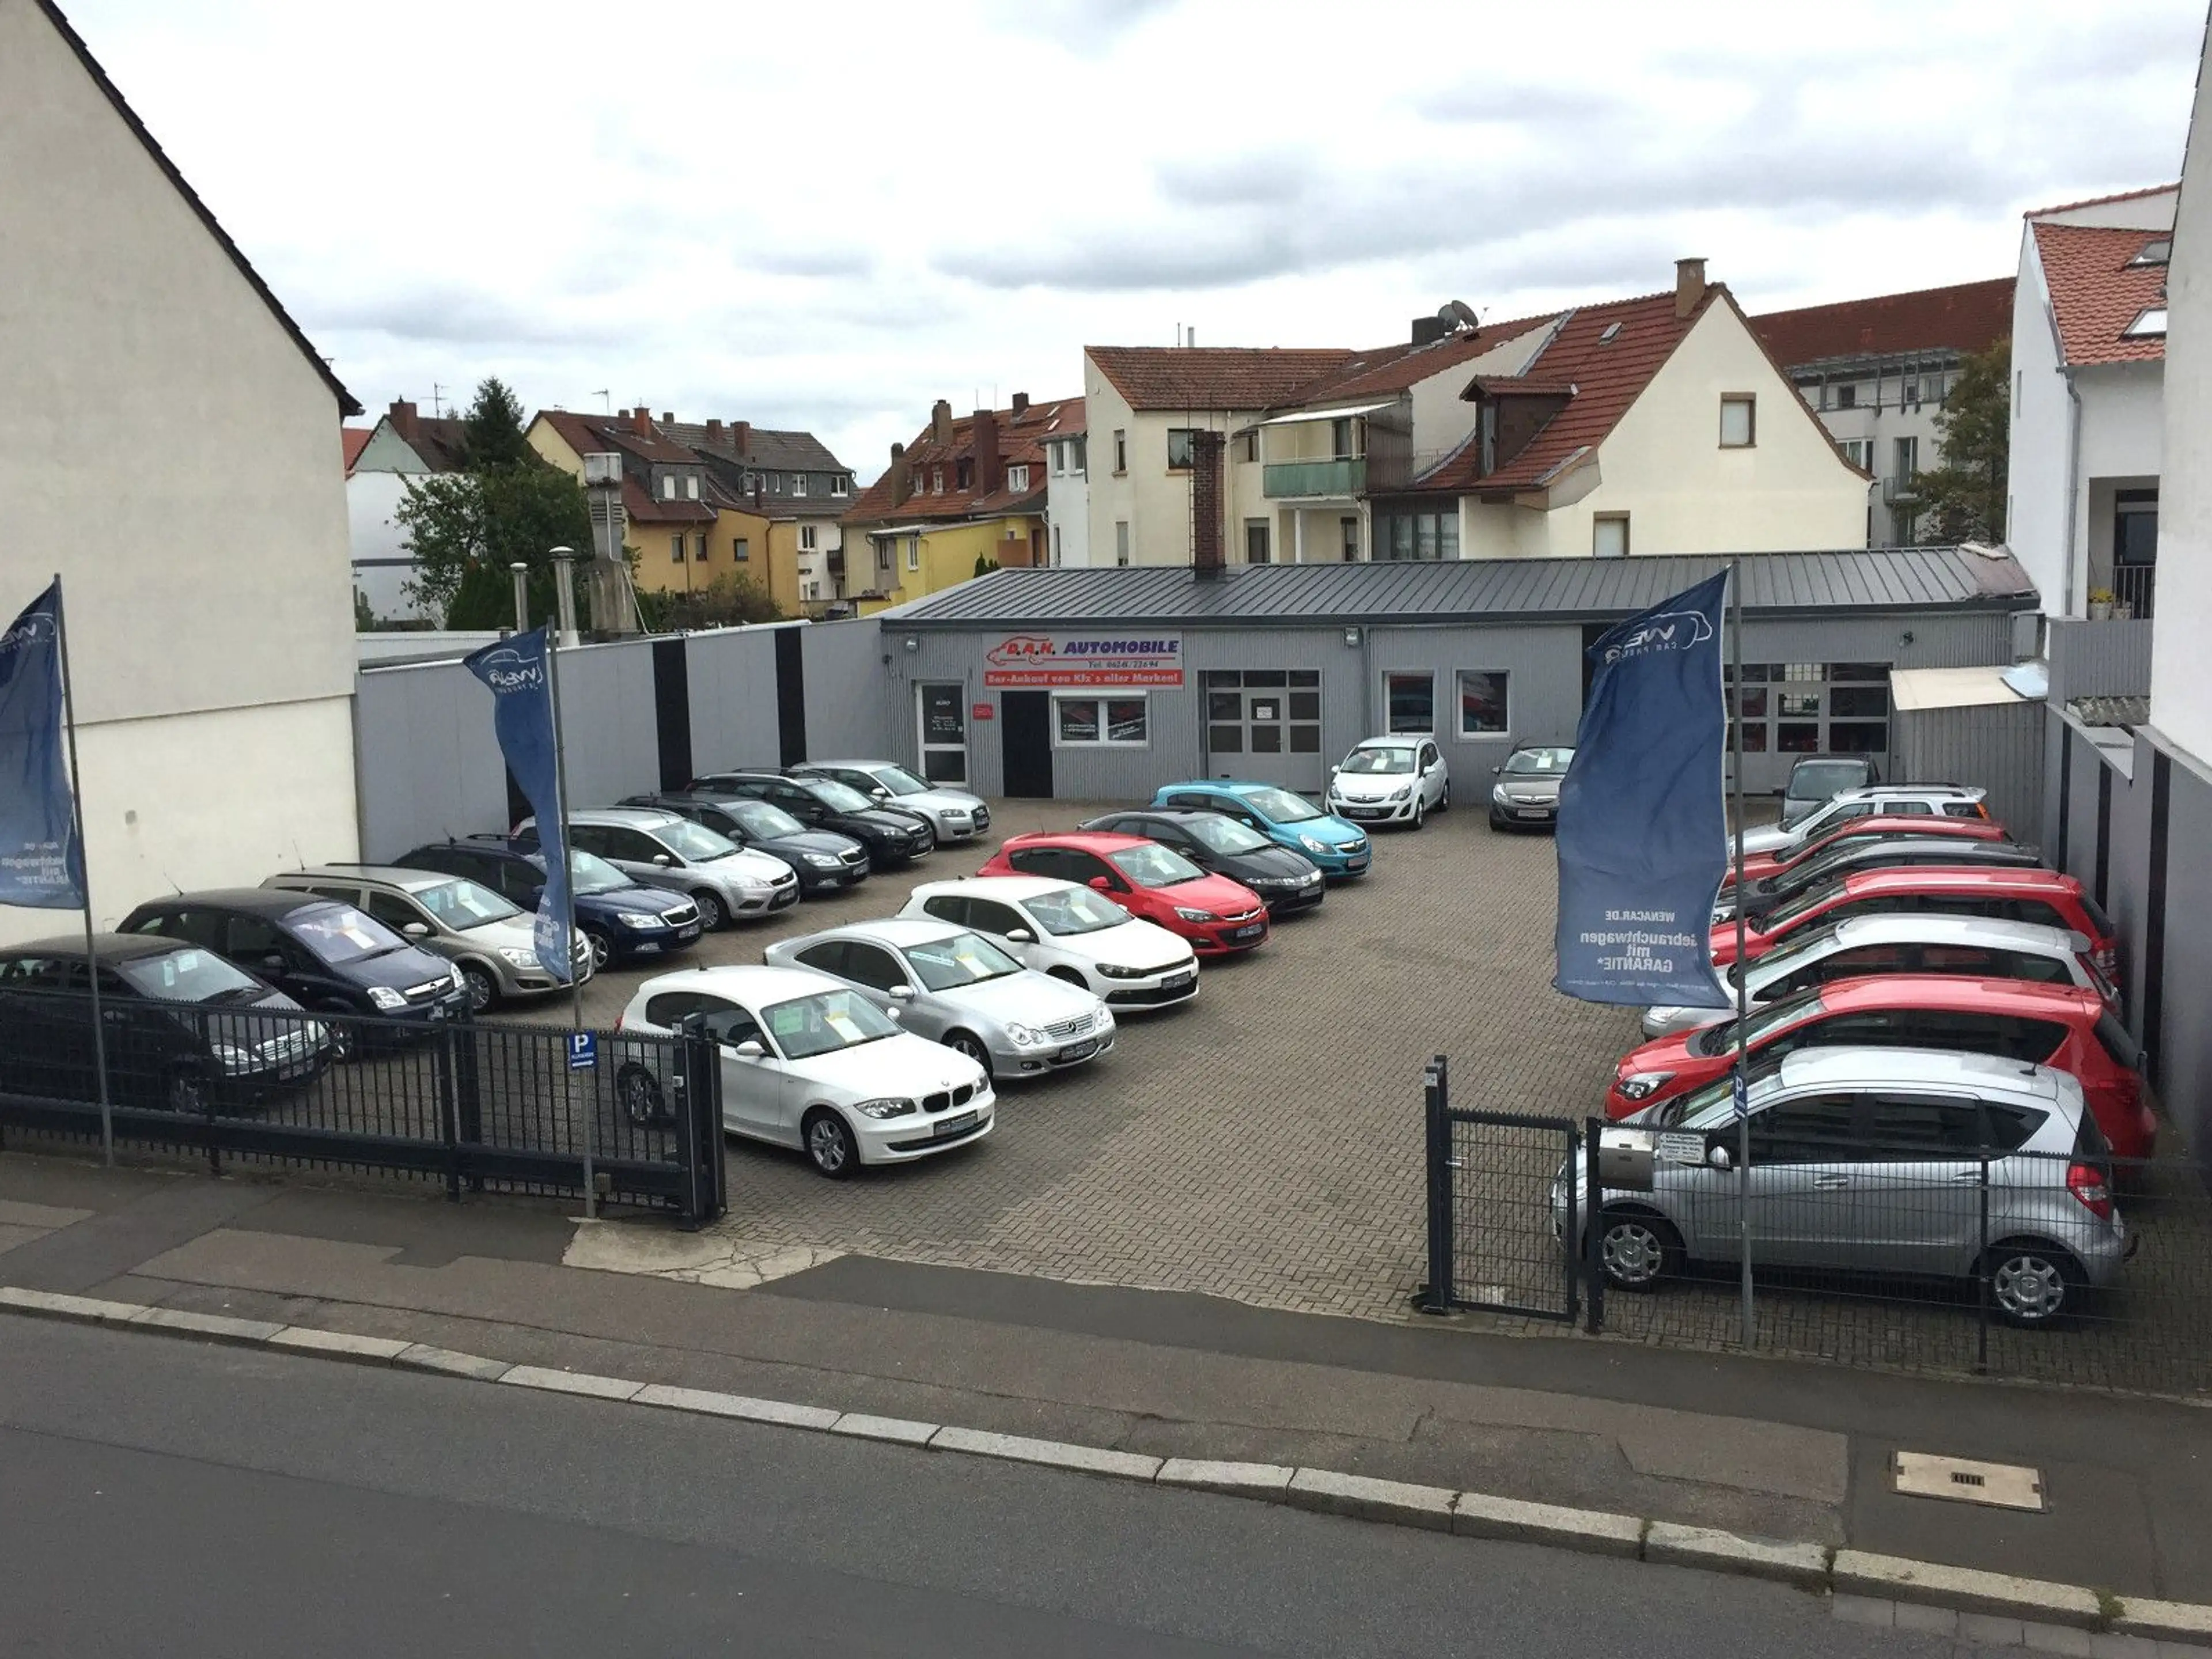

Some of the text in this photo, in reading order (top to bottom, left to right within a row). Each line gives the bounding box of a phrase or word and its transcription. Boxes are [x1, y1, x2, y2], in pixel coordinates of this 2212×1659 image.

[1063, 640, 1179, 654] AUTOMOBILE
[987, 673, 1048, 684] Bar-Ankauf
[1103, 672, 1129, 683] aller
[575, 1034, 589, 1052] P
[1736, 1075, 1743, 1098] P
